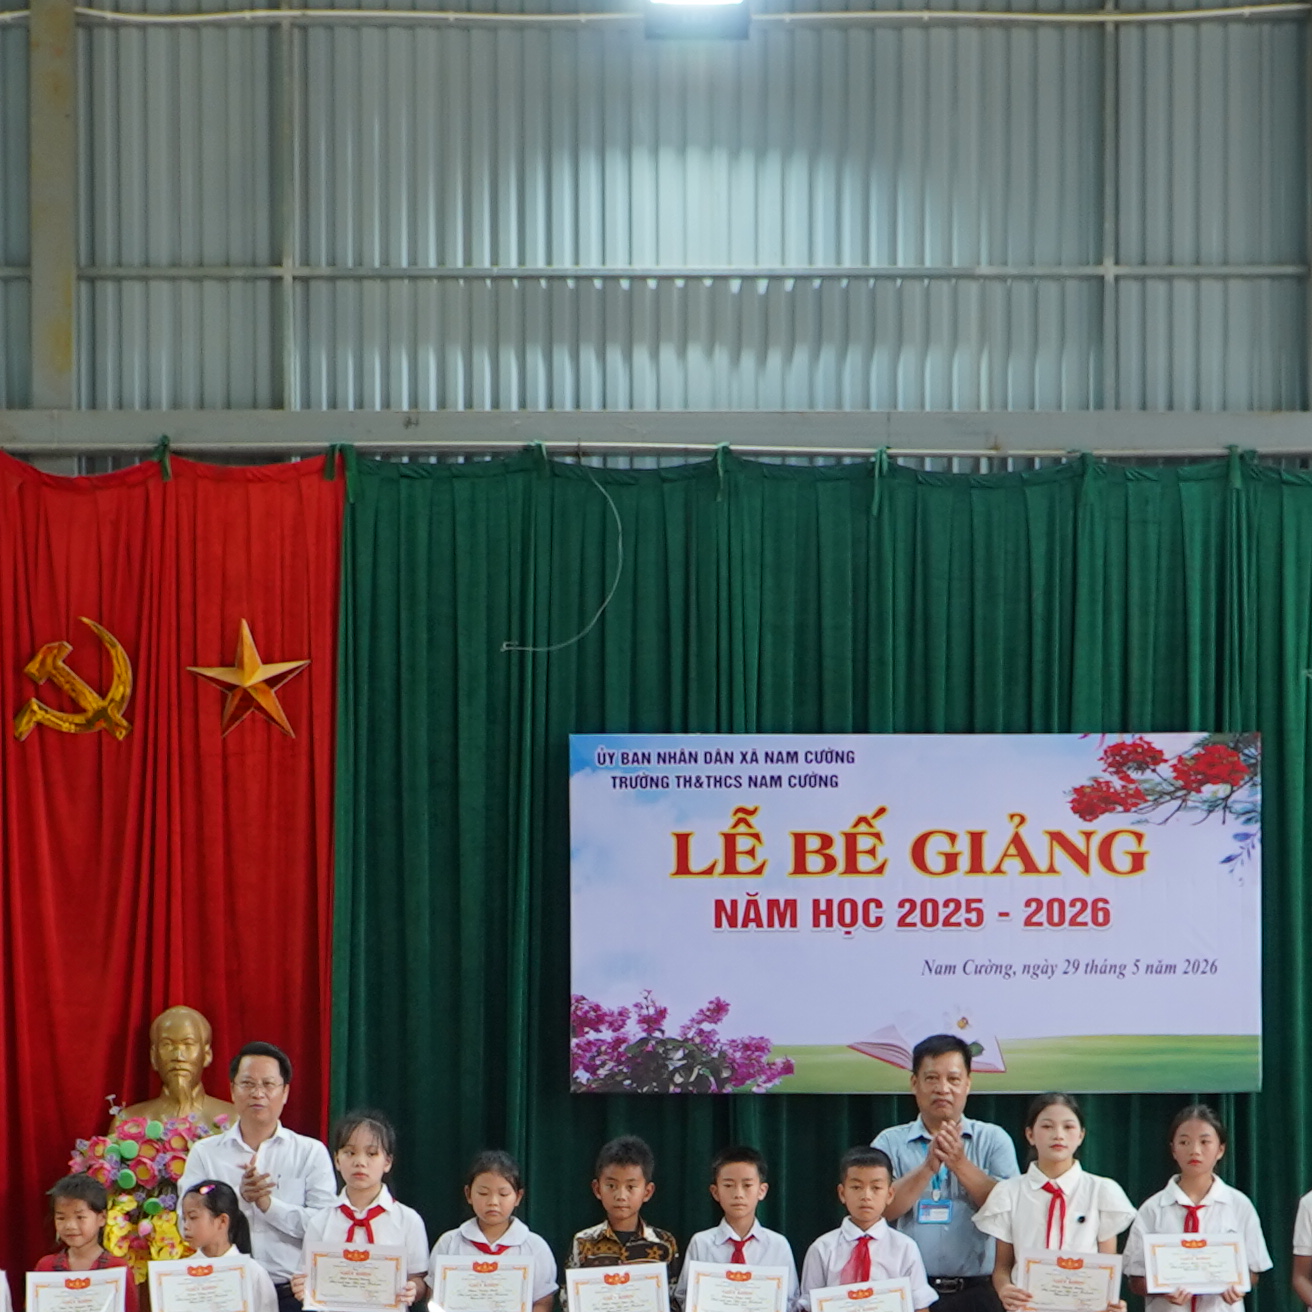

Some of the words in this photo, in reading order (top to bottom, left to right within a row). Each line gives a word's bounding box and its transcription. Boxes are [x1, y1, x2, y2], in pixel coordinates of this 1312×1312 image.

[597, 746, 616, 766] ỦY
[621, 751, 652, 766] BAN
[656, 748, 699, 765] NHÂN
[703, 748, 734, 765] DÂN
[739, 749, 759, 765] XÃ
[764, 750, 799, 765] NAM
[804, 748, 855, 765] CƯỜNG
[611, 773, 670, 790] TRƯỜNG
[675, 774, 743, 789] TH&THCS
[747, 774, 783, 789] NAM
[788, 773, 839, 789] CƯỜNG
[669, 805, 768, 878] LỄ
[787, 805, 890, 878] BẾ
[908, 812, 1150, 878] GIẢNG
[714, 892, 798, 929] NĂM
[812, 897, 884, 936] HỌC
[897, 897, 985, 928] 2025
[997, 911, 1011, 919] -
[1023, 897, 1111, 928] 2026
[921, 959, 957, 976] Nam
[962, 958, 1017, 980] Cường,
[1021, 958, 1058, 980] ngày
[1062, 958, 1081, 976] 29
[1085, 958, 1127, 980] tháng
[1131, 958, 1141, 976] 5
[1145, 959, 1177, 976] năm
[1182, 958, 1218, 976] 2026
